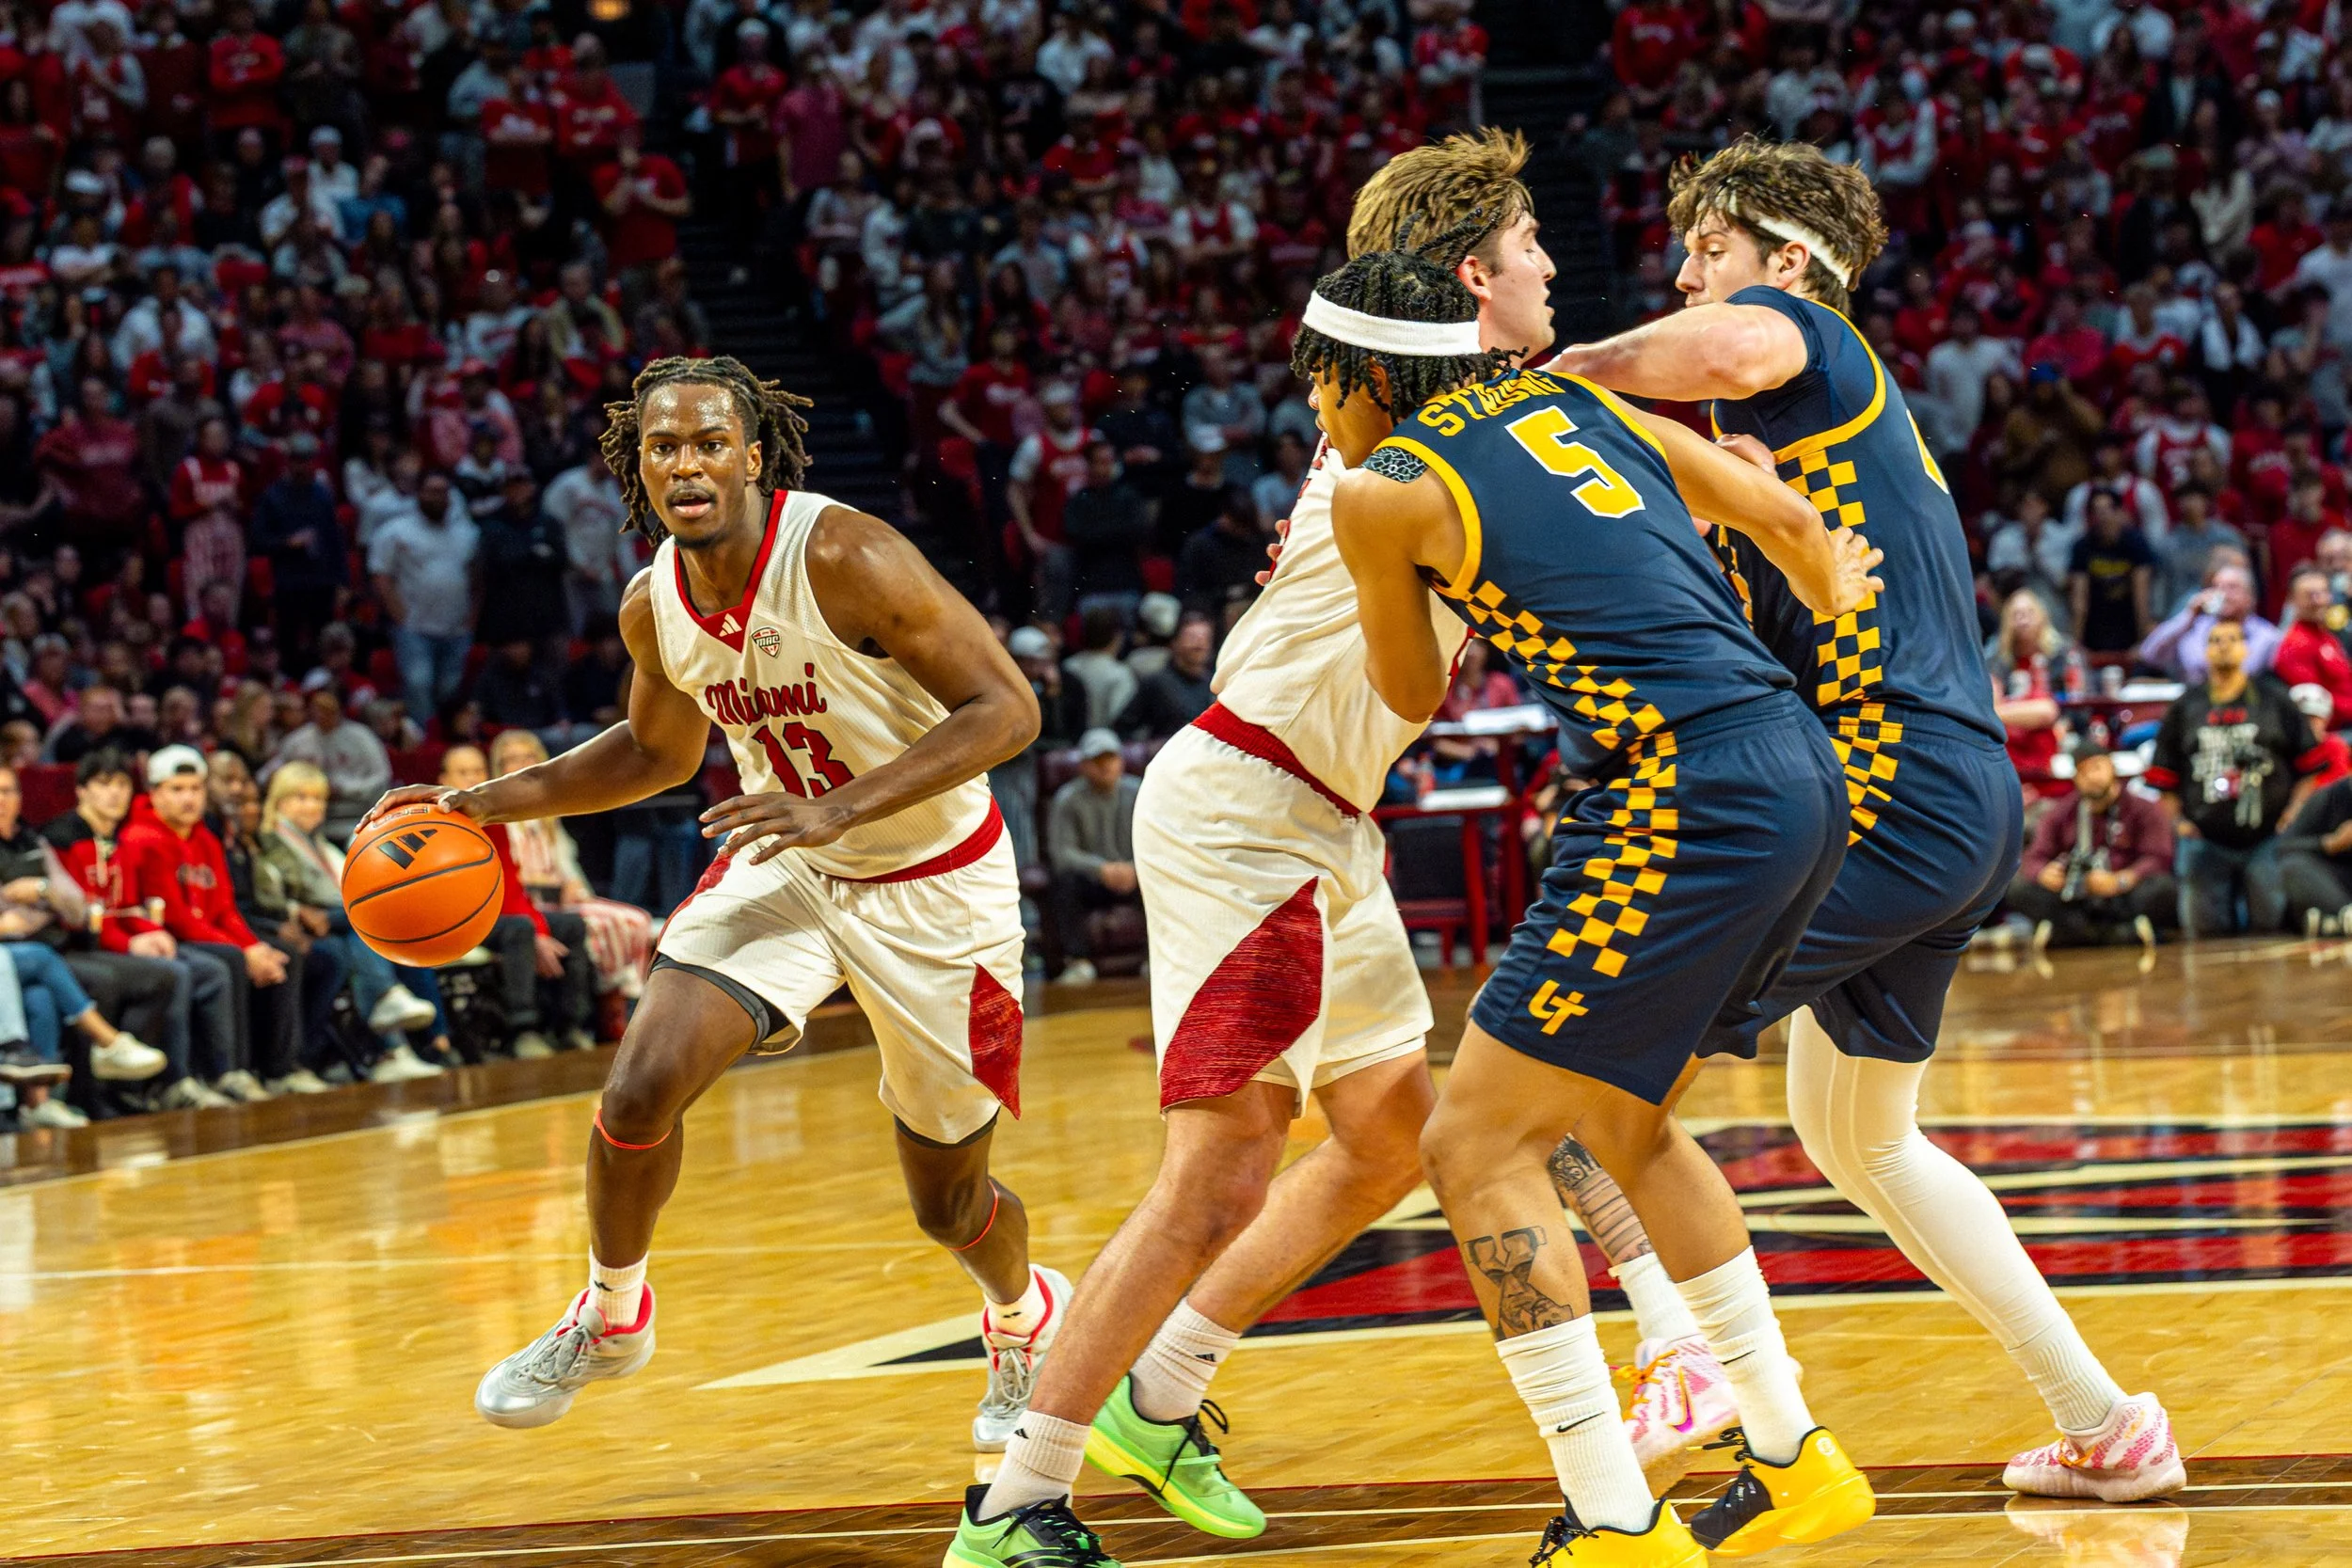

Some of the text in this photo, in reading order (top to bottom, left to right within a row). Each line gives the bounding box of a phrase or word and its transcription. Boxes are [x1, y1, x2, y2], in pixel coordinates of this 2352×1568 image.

[1504, 405, 1646, 519] 5
[755, 635, 780, 647] MAC
[705, 662, 828, 726] Miami
[752, 721, 855, 799] 13
